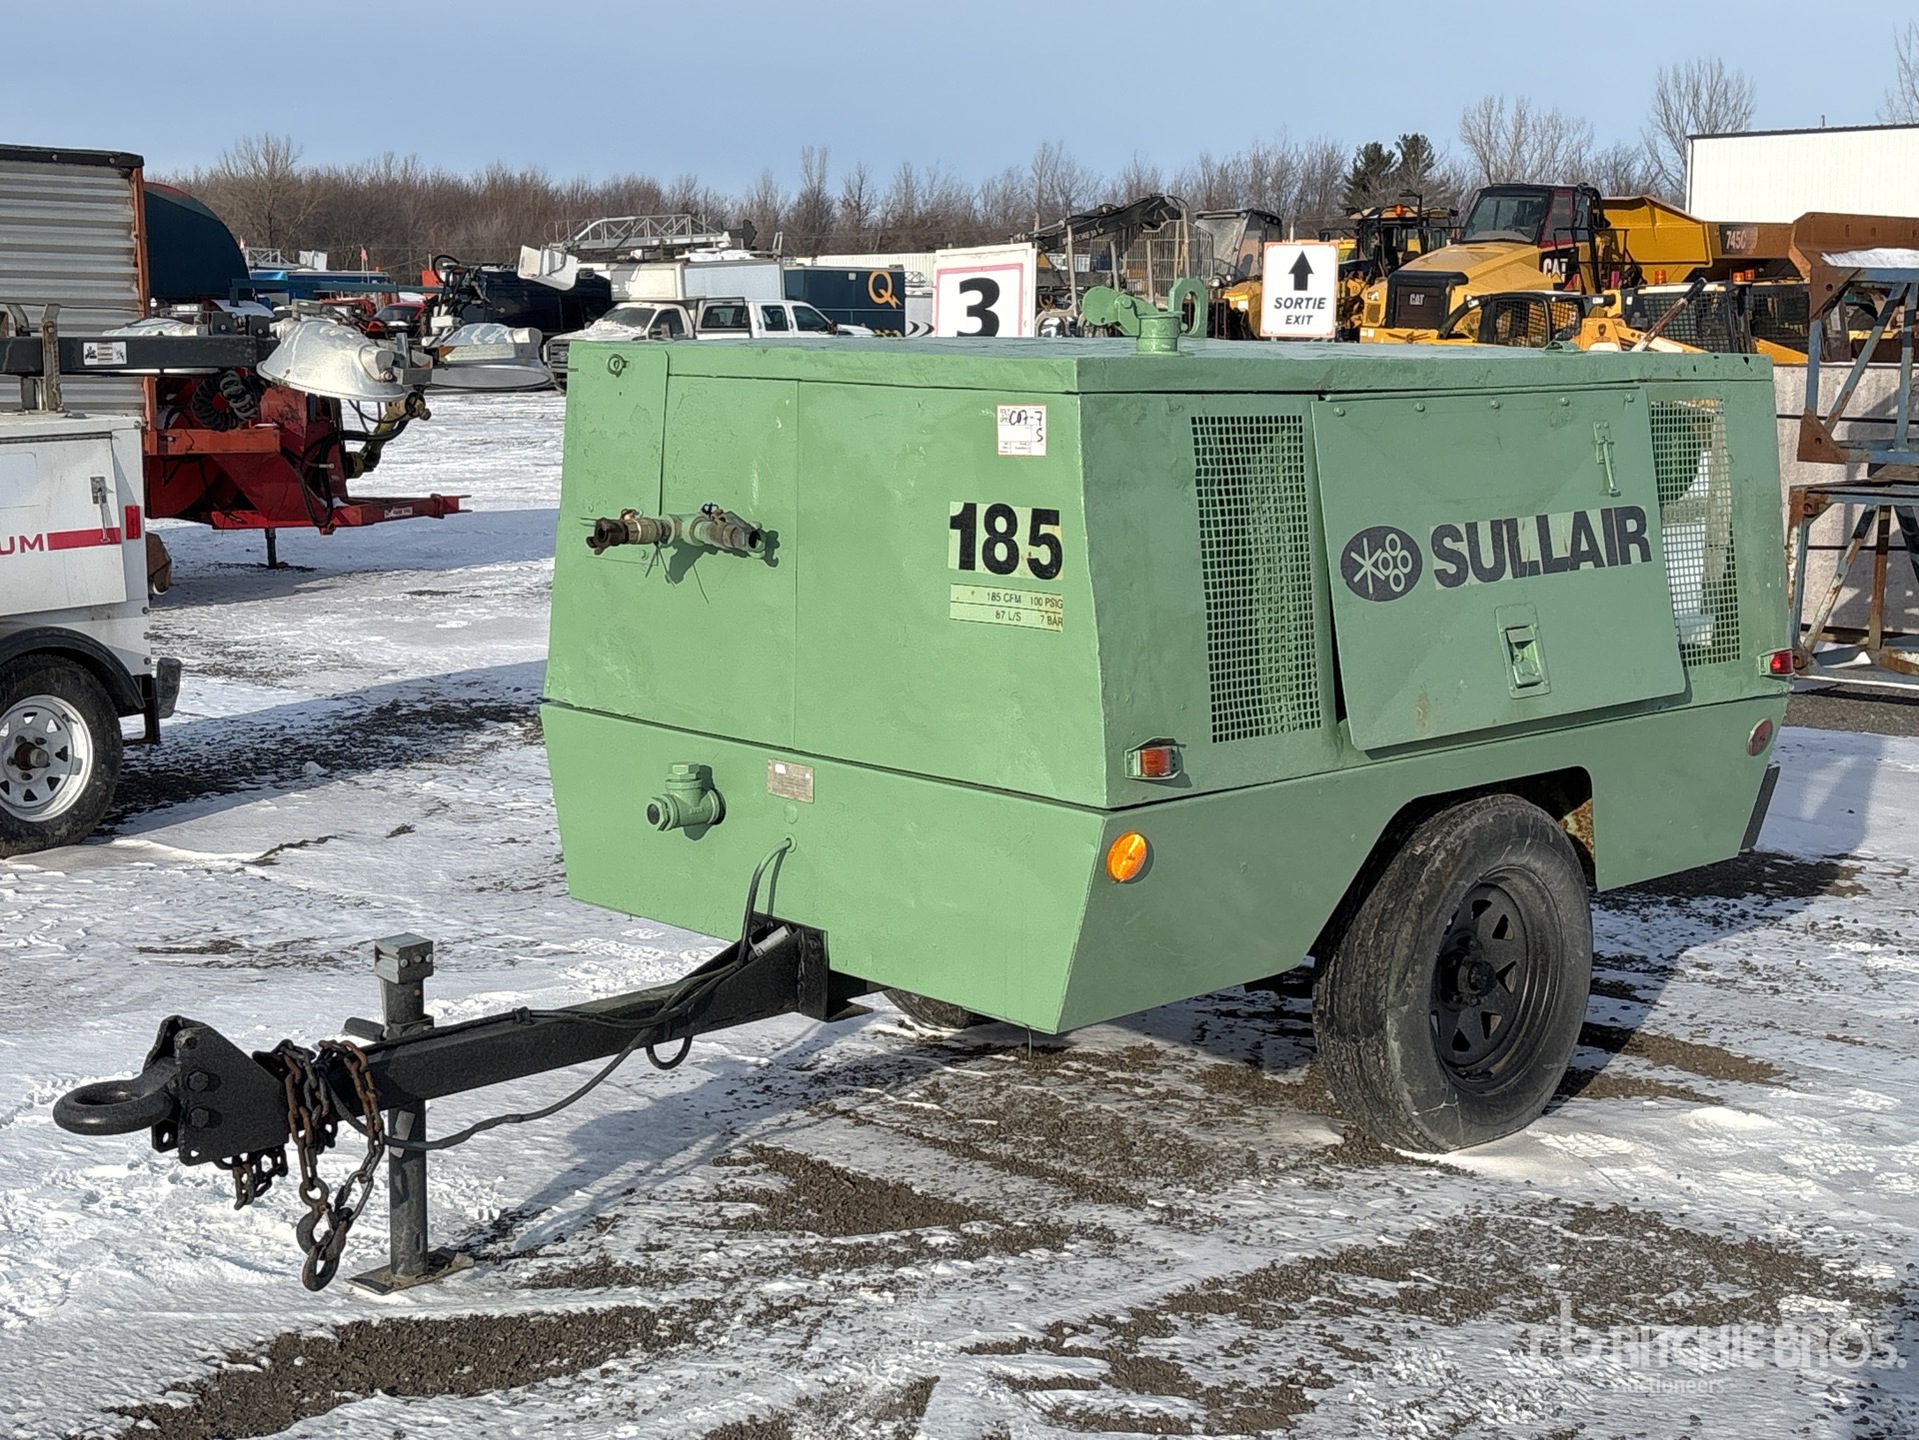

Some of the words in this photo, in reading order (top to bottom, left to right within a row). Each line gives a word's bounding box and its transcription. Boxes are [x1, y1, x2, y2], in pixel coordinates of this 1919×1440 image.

[1543, 258, 1568, 283] CAT
[957, 277, 1000, 337] 3
[1274, 297, 1327, 310] SORTIE
[1410, 294, 1424, 306] CAT
[1285, 314, 1314, 325] EXIT
[950, 502, 1063, 581] 185
[1431, 505, 1652, 588] SULLAIR
[987, 592, 1002, 602] 185
[1003, 592, 1022, 604] CFM
[1030, 596, 1043, 606] 100
[1045, 598, 1063, 609] PSIG
[1008, 611, 1022, 622] L/S
[1040, 614, 1044, 624] 7
[1046, 616, 1063, 627] BAR
